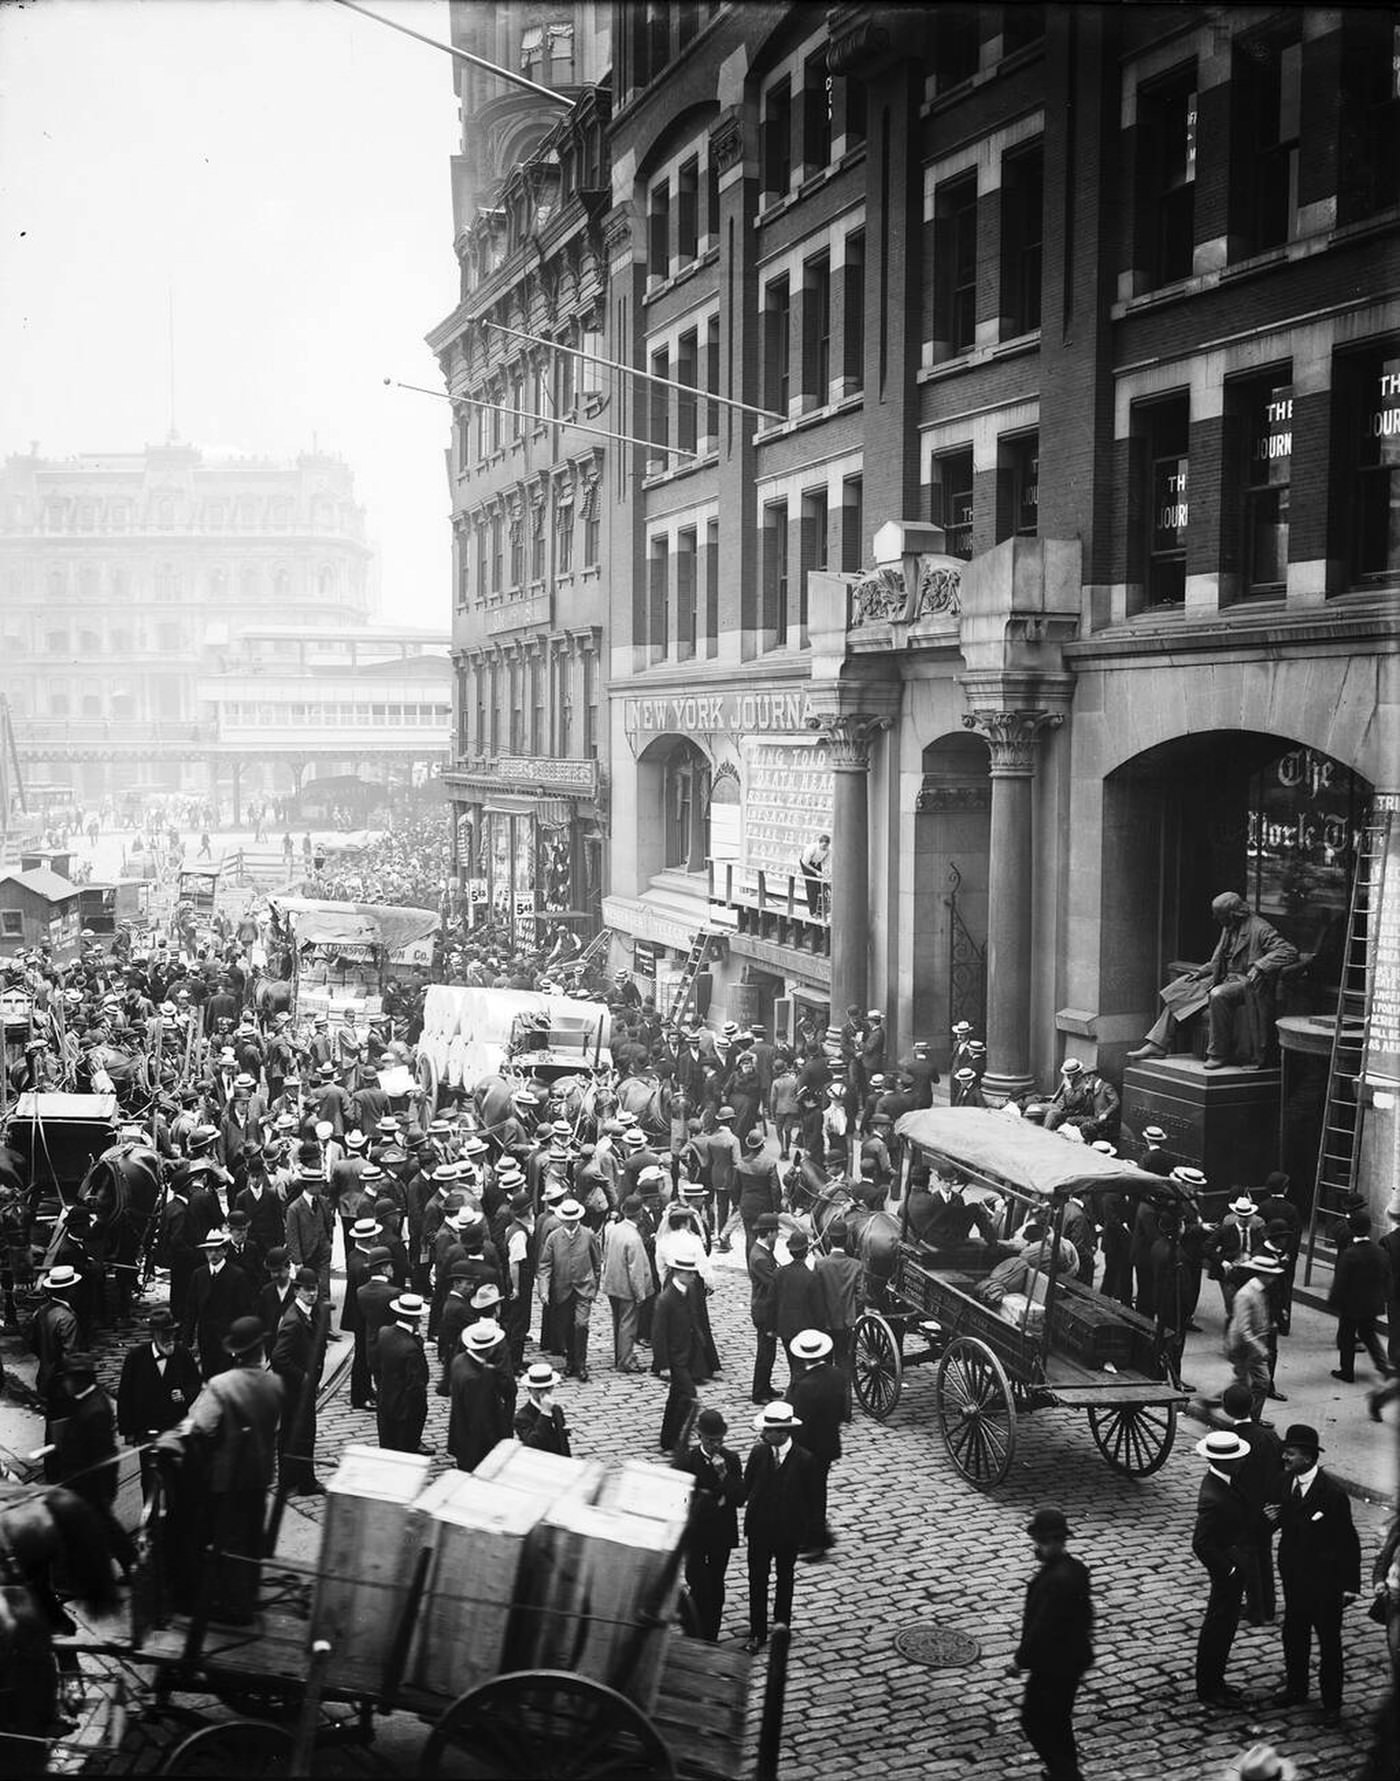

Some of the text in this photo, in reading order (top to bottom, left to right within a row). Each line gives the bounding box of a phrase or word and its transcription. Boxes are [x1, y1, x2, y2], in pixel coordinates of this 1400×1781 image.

[631, 699, 667, 731] NEW
[672, 696, 725, 731] YORK
[1277, 748, 1336, 801] The
